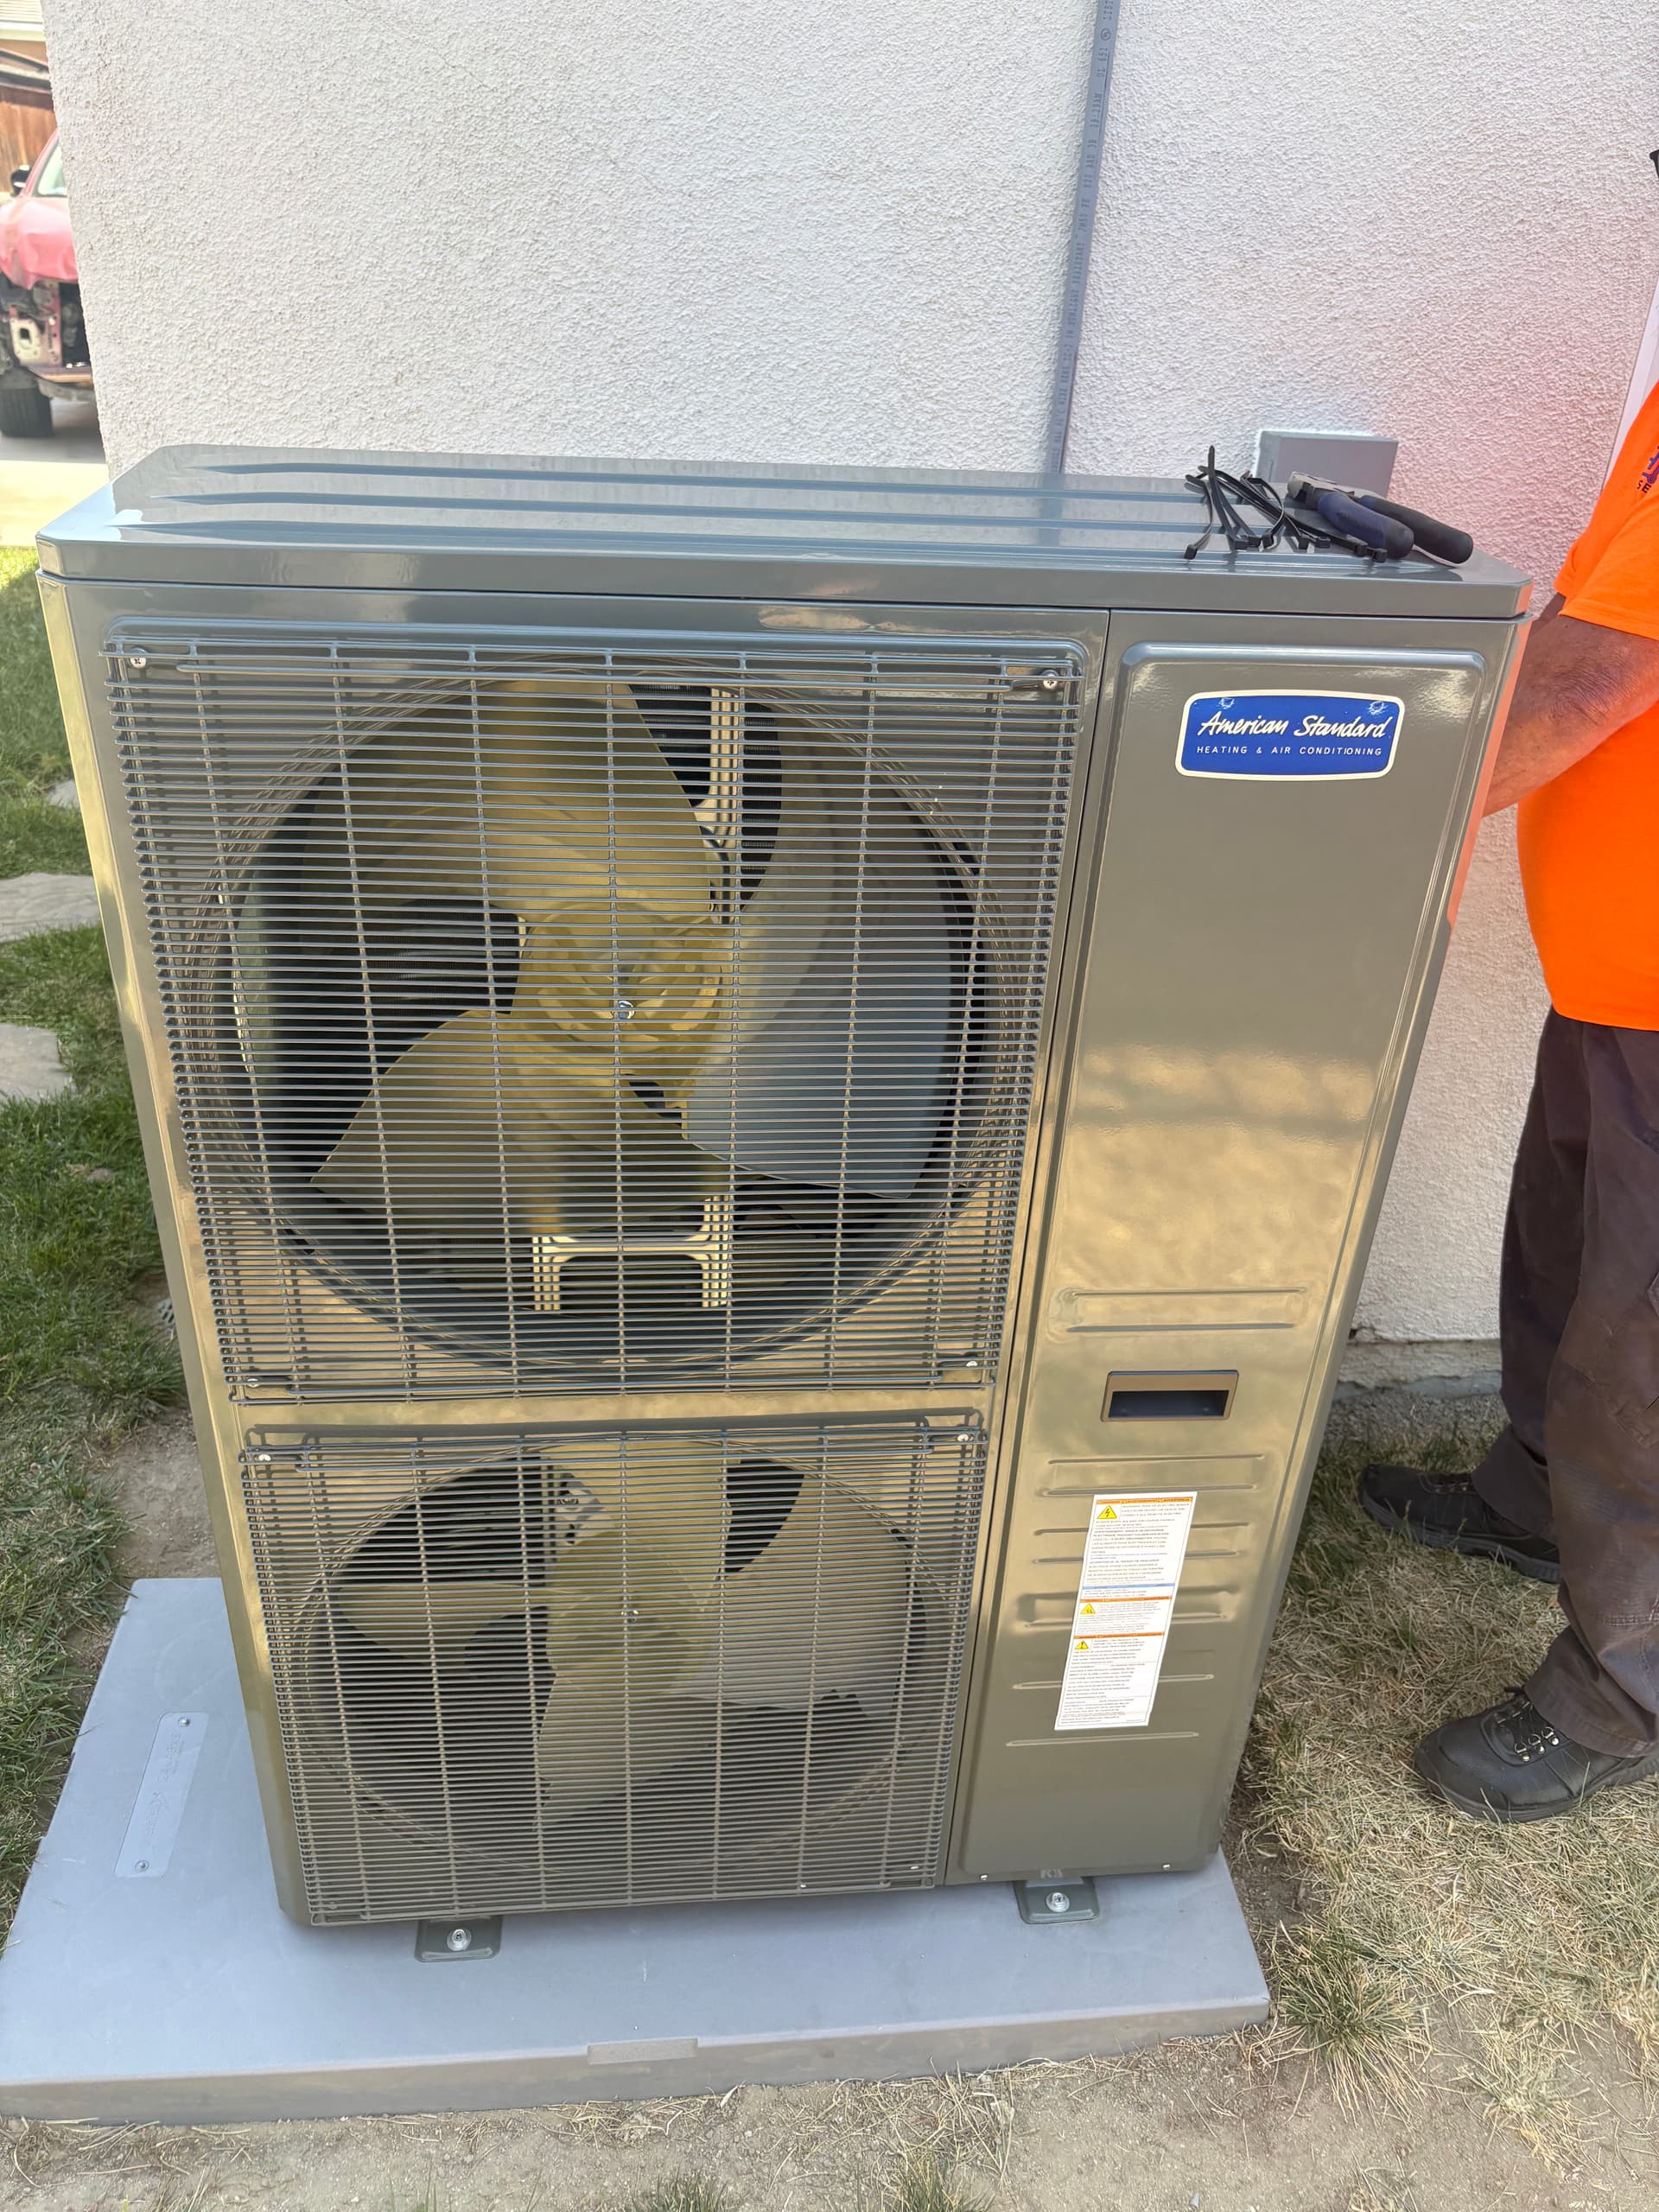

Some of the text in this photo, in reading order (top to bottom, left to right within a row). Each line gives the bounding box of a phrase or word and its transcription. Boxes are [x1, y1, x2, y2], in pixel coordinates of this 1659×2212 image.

[1198, 710, 1393, 739] American Standard
[1300, 747, 1382, 756] CONDITIONING
